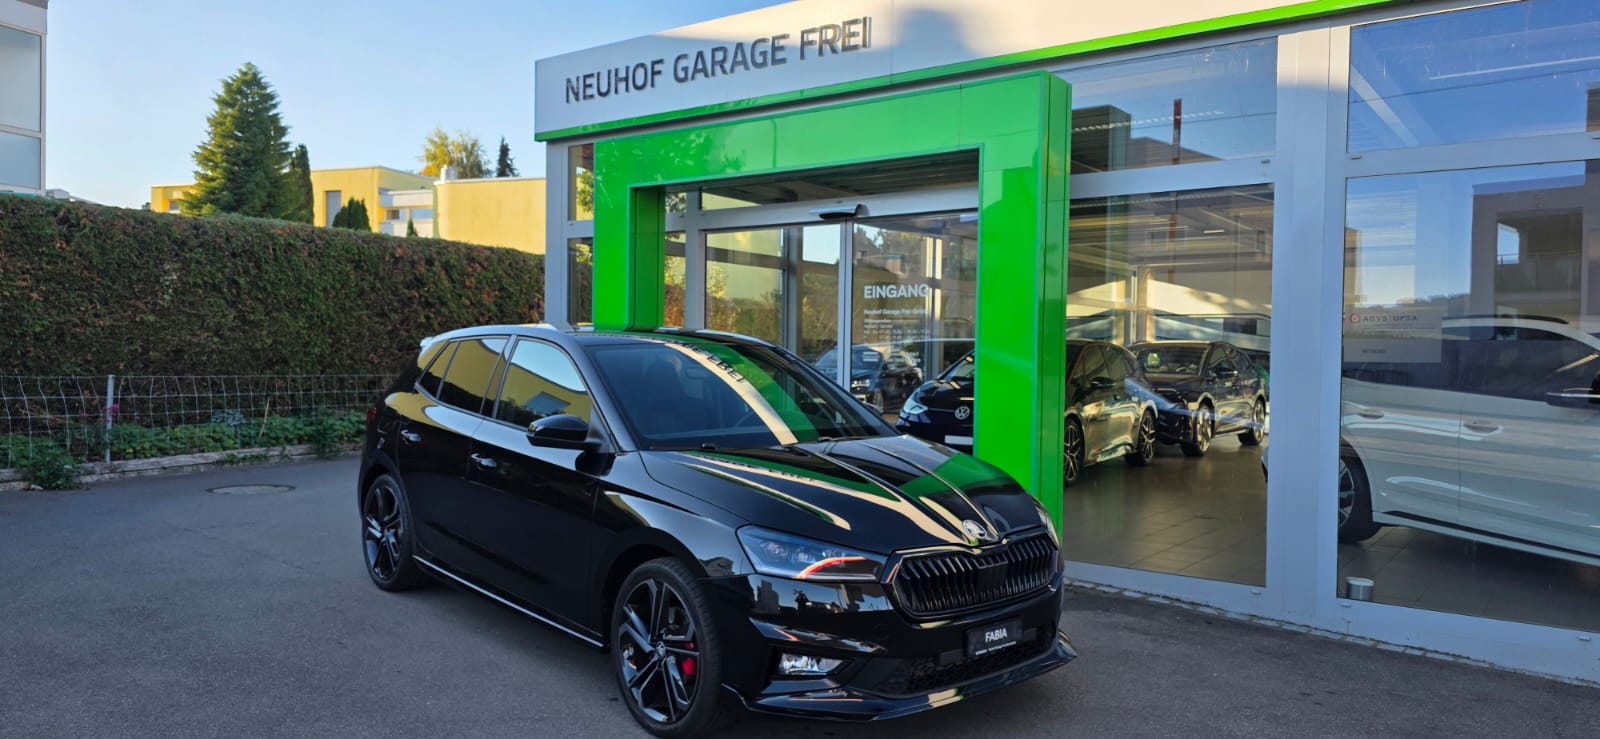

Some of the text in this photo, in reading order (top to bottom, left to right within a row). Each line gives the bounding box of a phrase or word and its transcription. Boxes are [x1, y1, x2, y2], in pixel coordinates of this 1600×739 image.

[565, 16, 872, 104] NEUHOF GARAGE FREI
[864, 284, 928, 298] EINGANG
[985, 628, 1007, 642] FABIA
